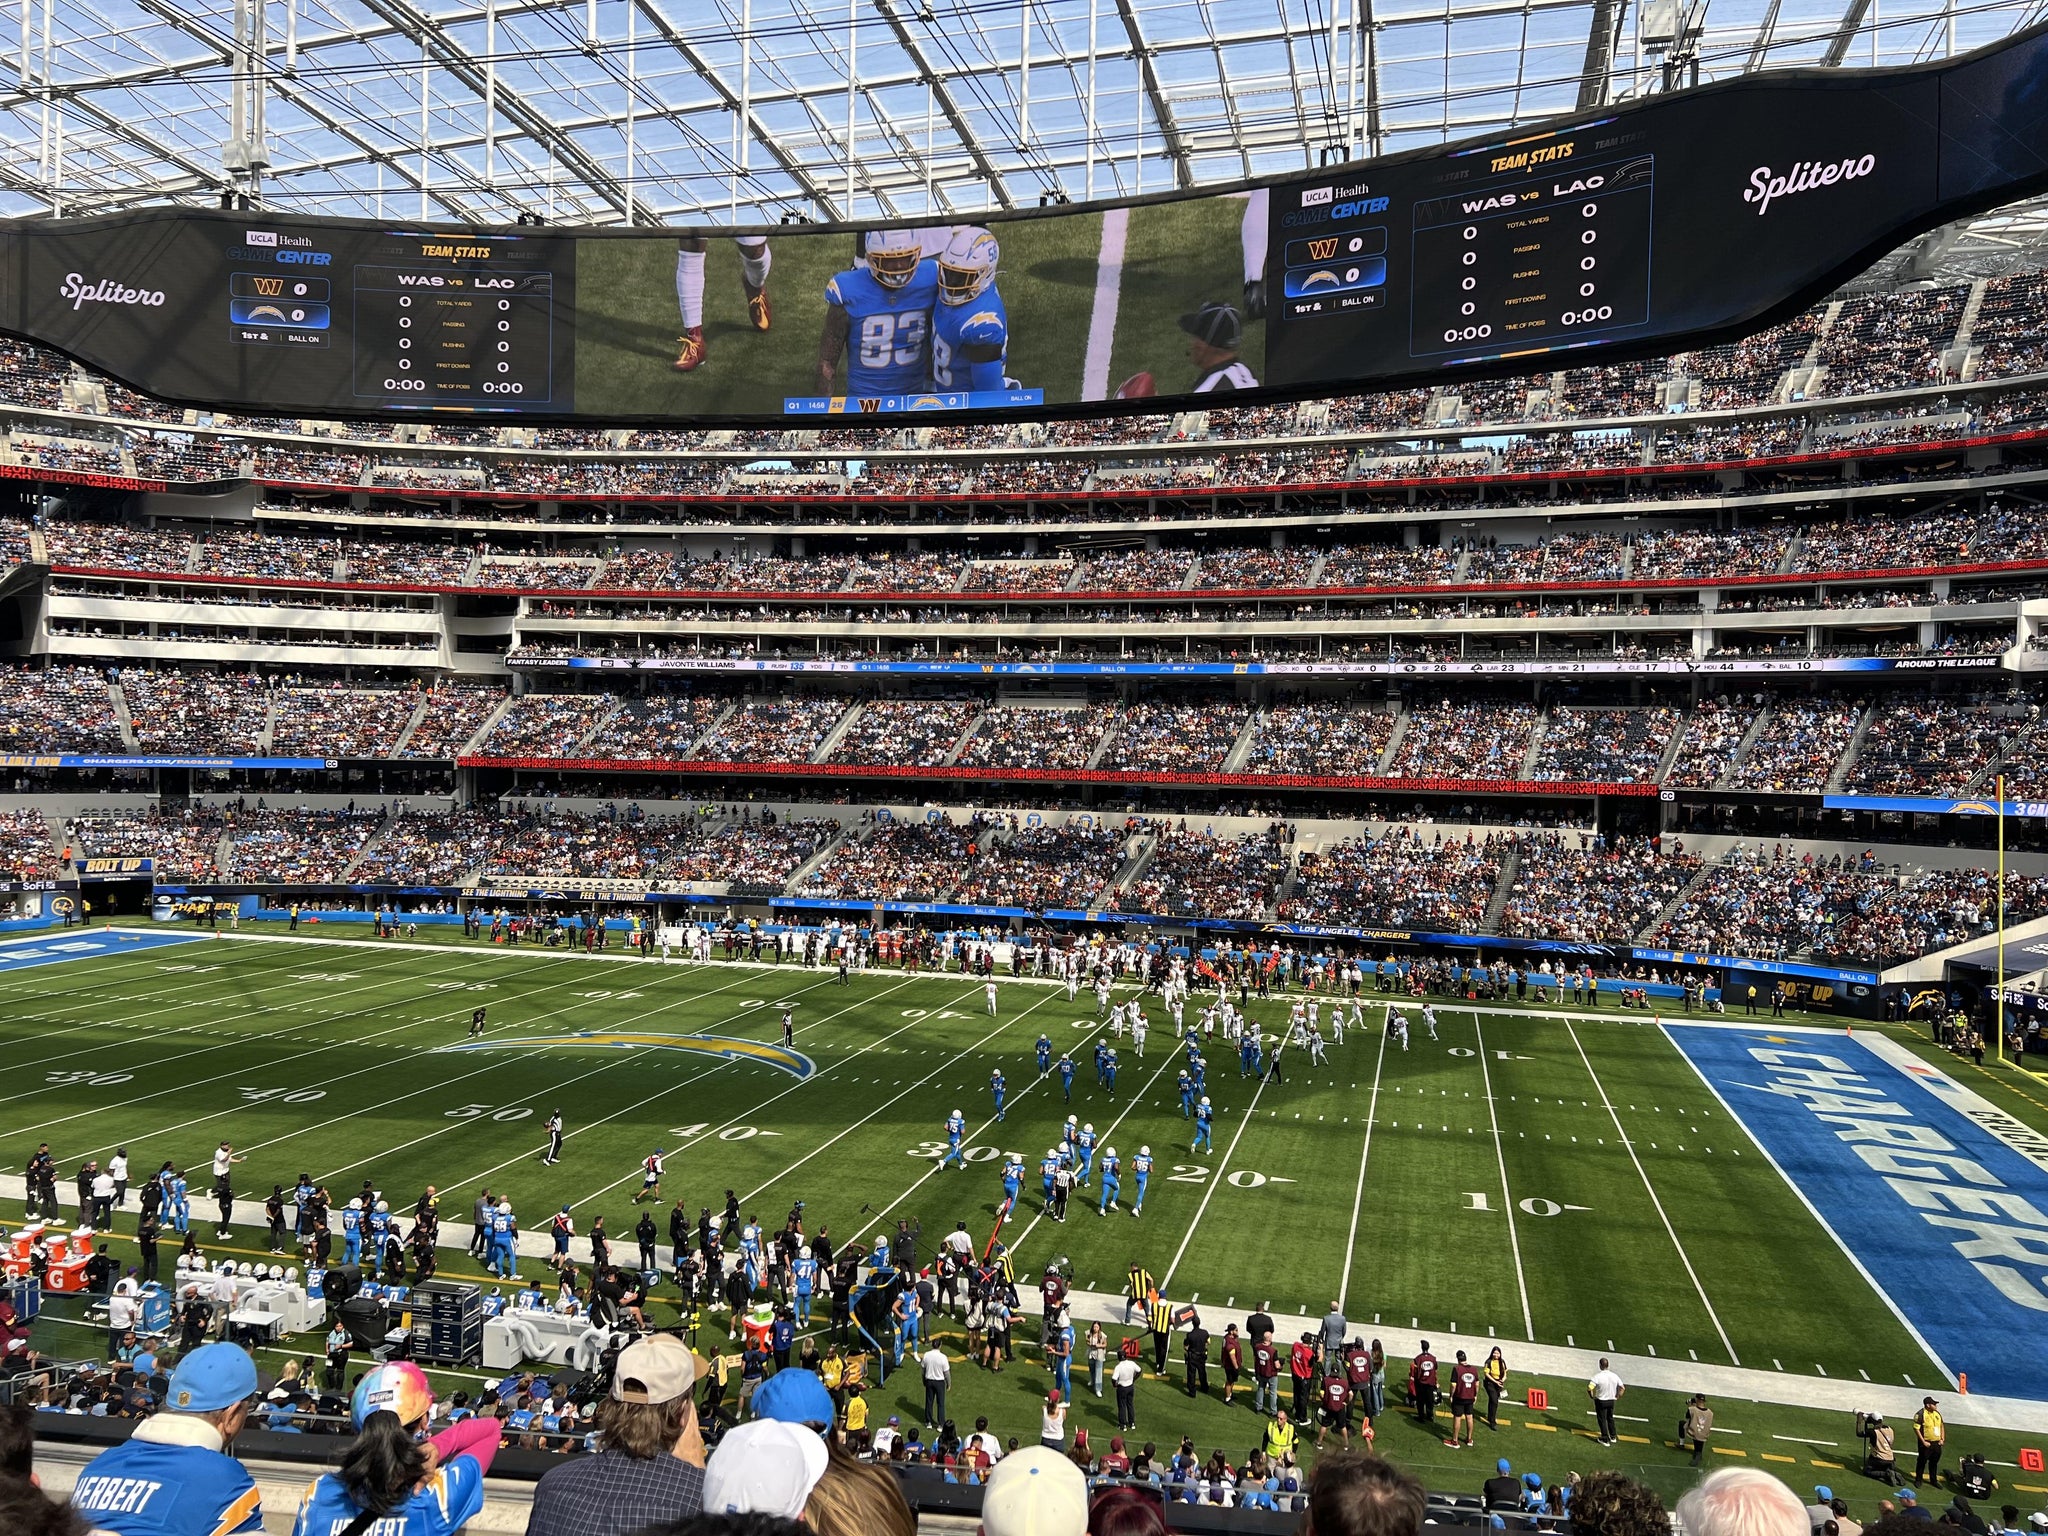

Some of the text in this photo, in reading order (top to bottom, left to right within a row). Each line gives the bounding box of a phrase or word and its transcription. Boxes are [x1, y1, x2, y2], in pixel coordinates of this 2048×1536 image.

[1491, 142, 1575, 173] TEAM STATS
[1744, 154, 1875, 215] Splitero
[1306, 184, 1369, 202] UCLA Health
[1462, 194, 1517, 214] WAS
[1553, 176, 1605, 196] LAC
[1282, 196, 1391, 228] GAME CENTER
[1463, 203, 1597, 240] 0 TOTAL YARDS 0
[250, 235, 313, 247] UCLA Health
[1349, 237, 1363, 252] 0
[1462, 230, 1597, 266] 0 PASSING 0
[226, 247, 332, 266] GAME CENTER
[421, 245, 491, 258] TEAM STATS
[1346, 268, 1360, 283] 0
[1461, 256, 1596, 290] 0 RUSHING 0
[293, 283, 307, 296] 0
[397, 275, 445, 287] WAS
[474, 278, 515, 289] LAC
[59, 272, 165, 310] Splitero
[399, 296, 412, 307] 0
[497, 299, 510, 311] 0
[1342, 298, 1361, 307] BALL
[1363, 295, 1375, 303] ON
[1461, 282, 1595, 316] 0 FIRST DOWNS 0
[291, 309, 305, 322] 0
[399, 317, 412, 328] 0
[497, 320, 510, 332] 0
[1443, 324, 1492, 343] 0:00
[1561, 305, 1613, 326] 0:00
[288, 334, 307, 343] BALL
[308, 335, 320, 343] ON
[399, 338, 412, 349] 0
[497, 341, 510, 352] 0
[860, 311, 926, 368] 83
[398, 358, 412, 370] 0
[497, 361, 510, 373] 0
[383, 378, 524, 394] 0:00 0:00
[788, 402, 800, 410] Q1
[887, 399, 896, 408] 0
[949, 397, 957, 406] 0
[32, 470, 86, 484] verizon
[507, 658, 538, 666] FANTASY
[790, 662, 805, 670] 135
[1434, 664, 1447, 672] 26
[1501, 664, 1515, 672] 23
[1646, 663, 1658, 671] 17
[1797, 662, 1811, 670] 10
[1895, 660, 1937, 668] AROUND
[1957, 658, 1997, 666] LEAGUE
[1662, 791, 1674, 799] CC
[2015, 804, 2025, 815] 3
[86, 859, 141, 872] BOLT UP
[23, 881, 45, 891] SoFi
[461, 888, 646, 901] SEE THE LIGHTNING FEEL THE THUNDER
[1299, 925, 1411, 939] LOS ANGELES CHARGERS
[1839, 973, 1857, 981] BALL
[1812, 985, 1834, 1001] UP
[1990, 989, 2012, 1004] SFi
[45, 1071, 134, 1086] 30
[241, 1088, 327, 1103] 40
[444, 1104, 534, 1121] 50
[668, 1123, 758, 1141] 40
[949, 1122, 958, 1133] 75
[1080, 1136, 1090, 1147] 73
[906, 1142, 1001, 1162] 30
[1136, 1161, 1149, 1172] 86
[1166, 1165, 1267, 1188] 20
[1461, 1192, 1562, 1217] 10
[49, 1269, 63, 1288] G
[798, 1265, 811, 1278] 41
[1530, 1391, 1543, 1406] 10
[2026, 1451, 2039, 1468] G
[71, 1476, 163, 1514] HERBERT
